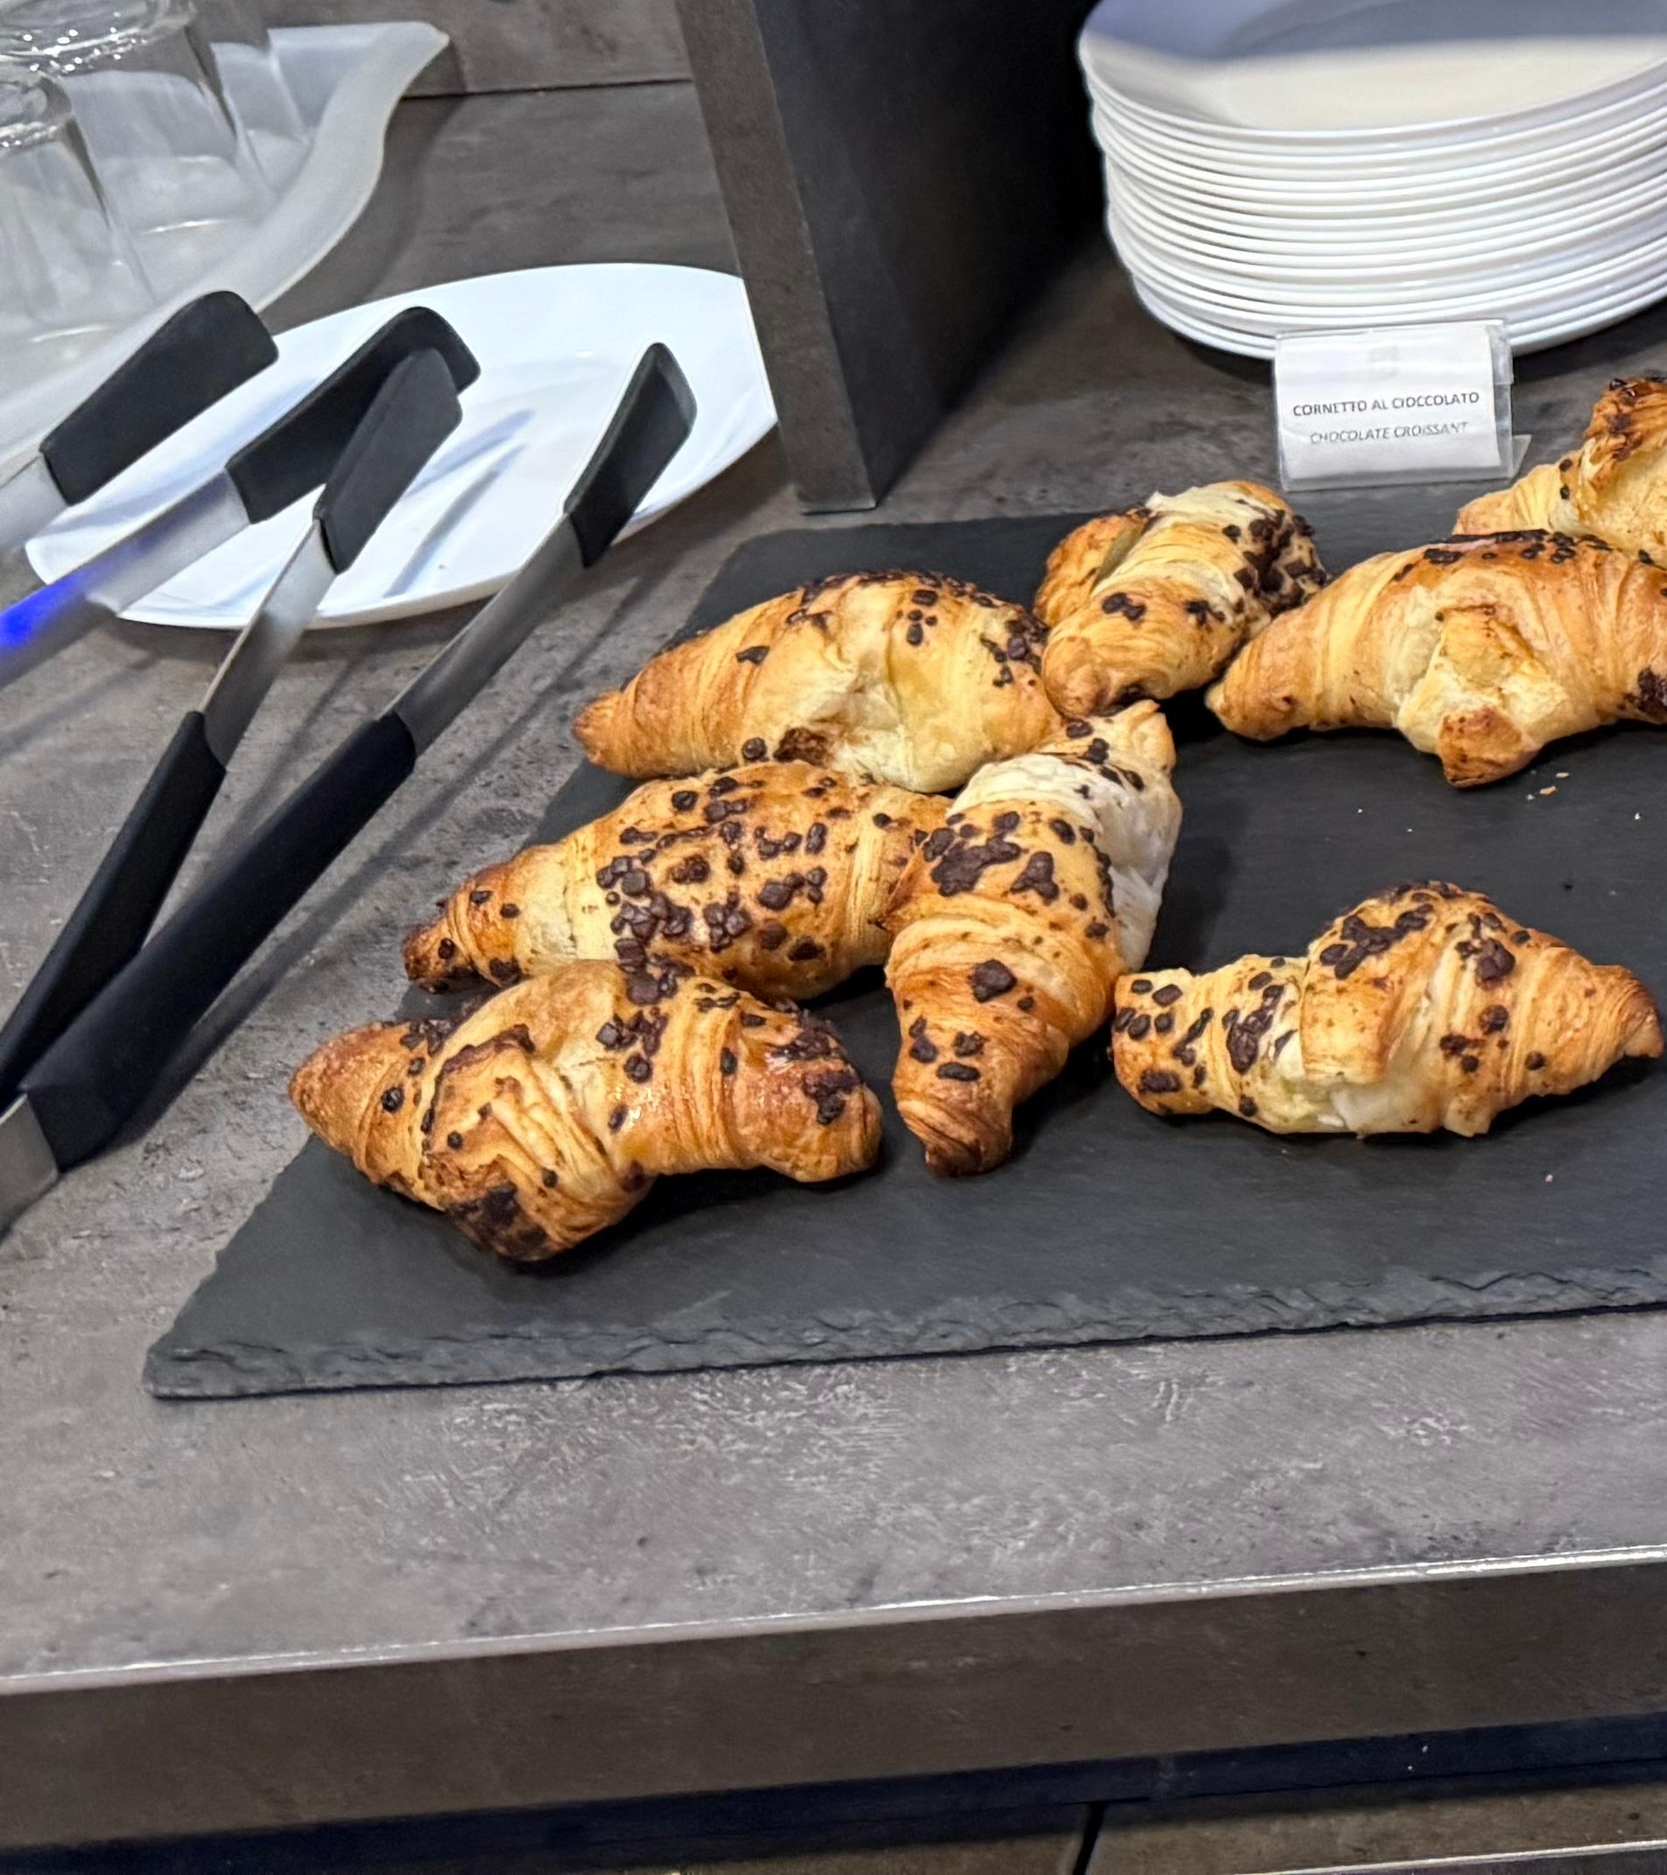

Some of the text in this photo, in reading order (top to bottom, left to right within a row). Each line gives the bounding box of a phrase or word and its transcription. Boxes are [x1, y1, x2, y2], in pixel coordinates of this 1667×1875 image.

[1292, 391, 1480, 417] CORNETTO AL CIOCCOLATO
[1309, 421, 1469, 445] CHOCOLATE CROISSANT
